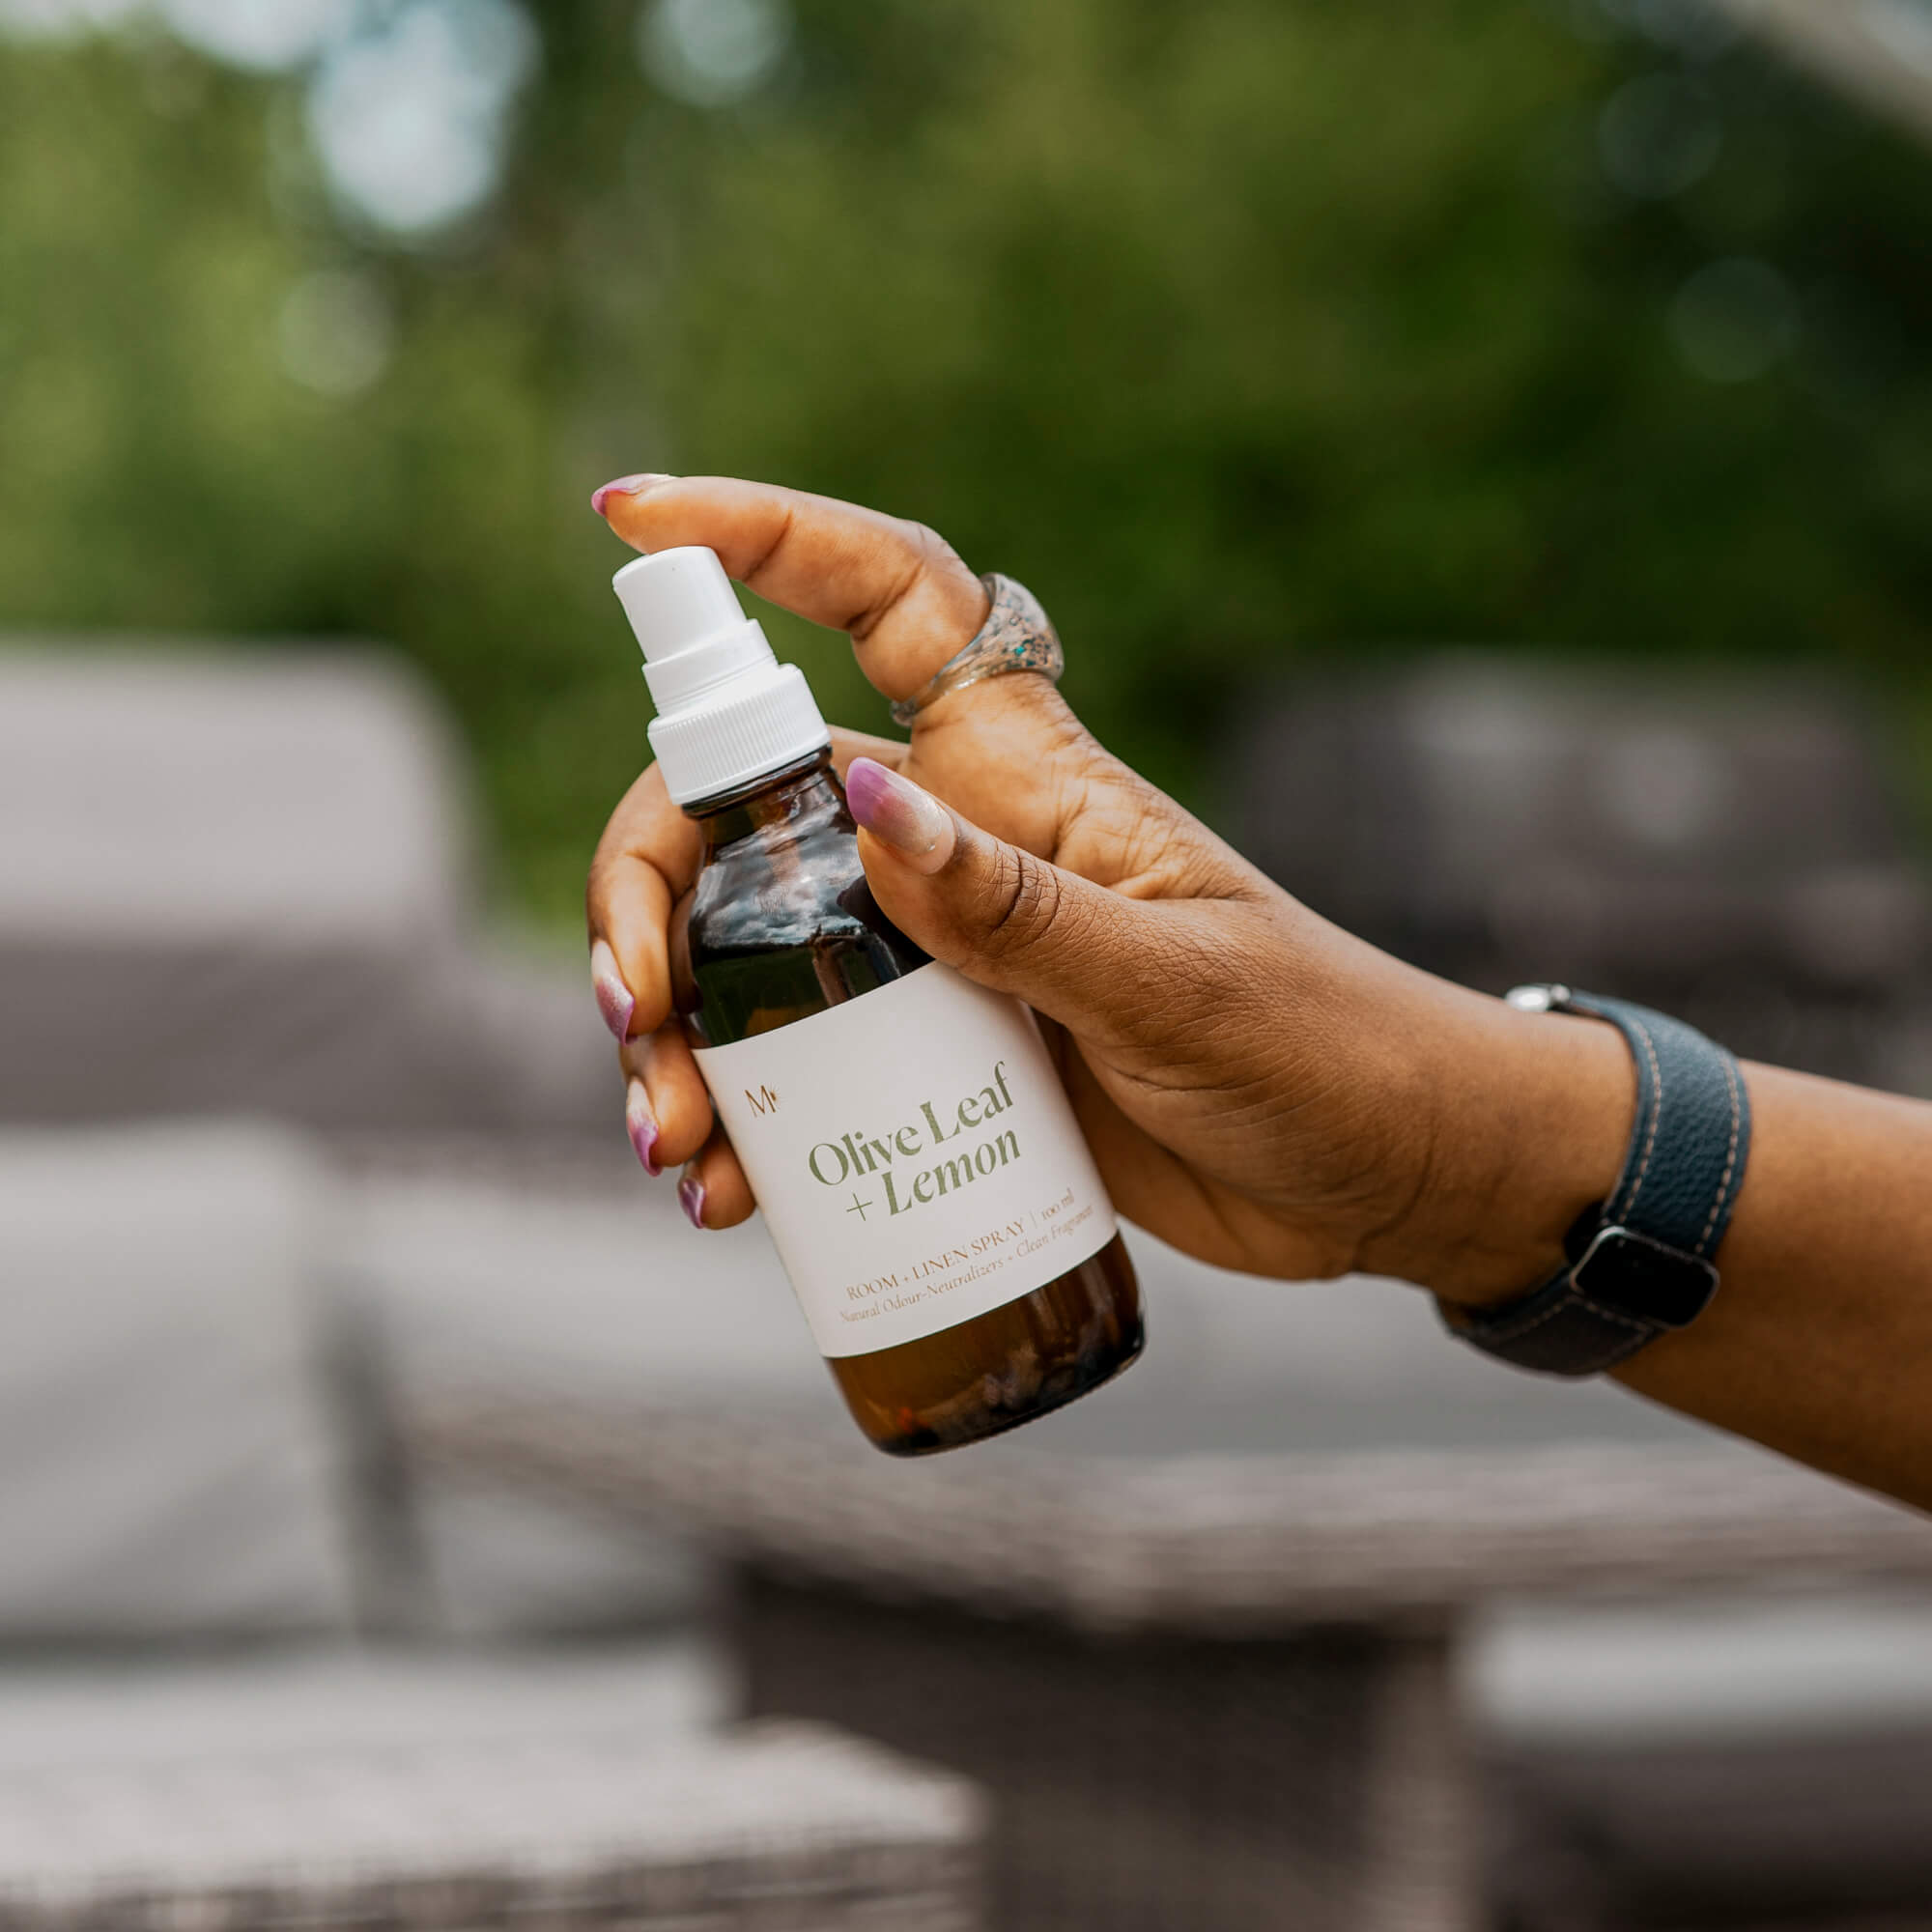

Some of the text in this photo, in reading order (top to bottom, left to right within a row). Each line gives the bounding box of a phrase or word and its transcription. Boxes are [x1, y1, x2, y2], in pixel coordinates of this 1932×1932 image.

[809, 1061, 1014, 1186] Olive Leaf
[846, 1129, 1021, 1221] + Lemon
[840, 1300, 881, 1322] Natural
[883, 1258, 1005, 1313] Odour-Neutralizers
[1015, 1236, 1050, 1258] Clean
[846, 1274, 899, 1299] ROOM
[911, 1244, 969, 1280] LINEN
[970, 1216, 1025, 1257] SPRAY
[1041, 1203, 1061, 1220] 100
